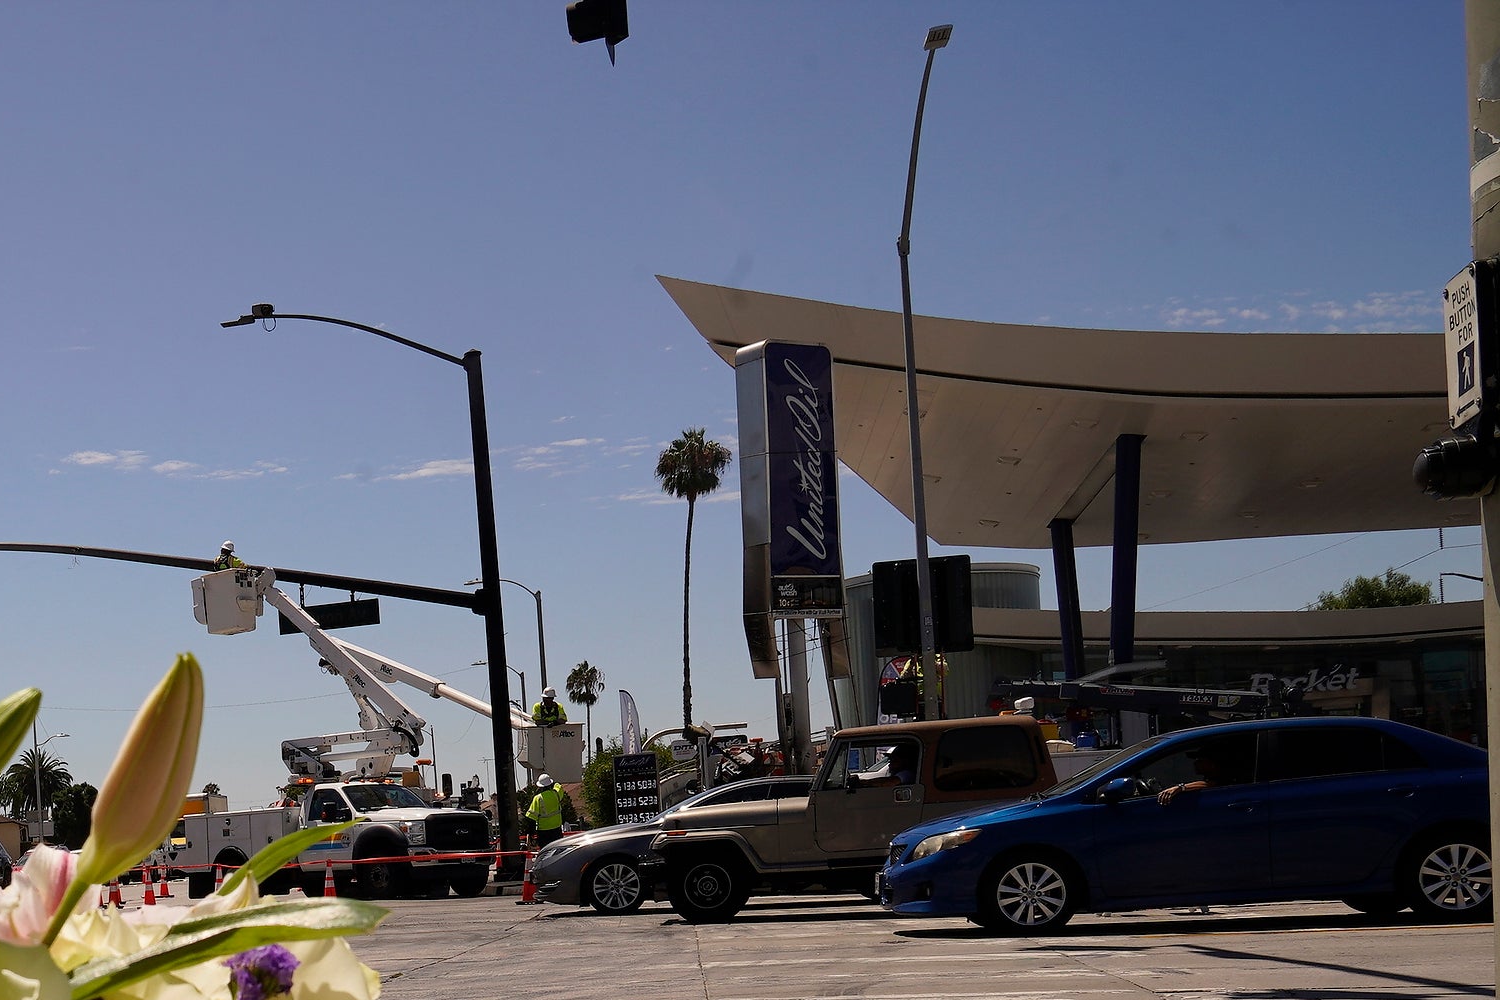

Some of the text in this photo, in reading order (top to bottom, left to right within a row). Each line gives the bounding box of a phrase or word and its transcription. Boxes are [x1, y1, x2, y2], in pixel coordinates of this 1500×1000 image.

[1451, 281, 1471, 309] PUSH
[1449, 299, 1476, 331] BUTTON
[1458, 322, 1473, 345] FOR
[784, 358, 827, 560] United Oil
[1250, 667, 1360, 693] Rcket
[559, 730, 576, 738] Altec
